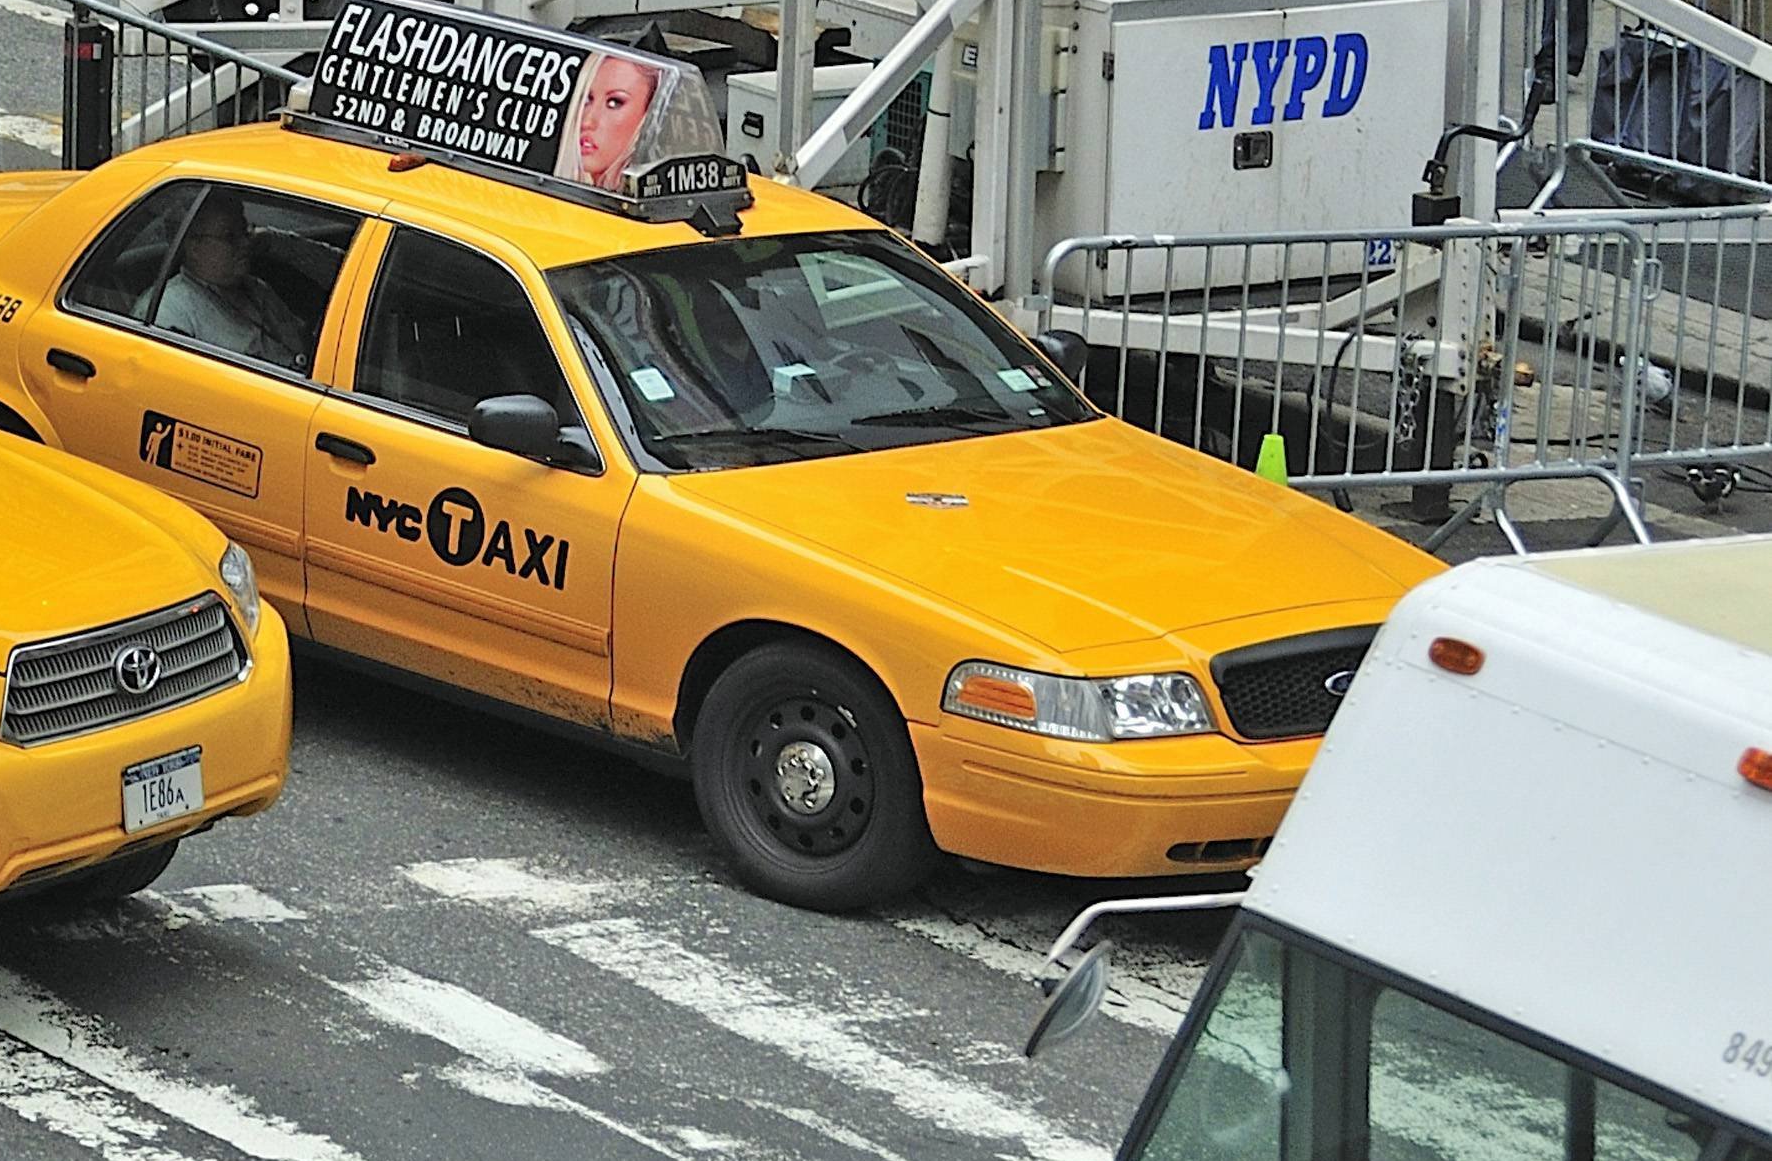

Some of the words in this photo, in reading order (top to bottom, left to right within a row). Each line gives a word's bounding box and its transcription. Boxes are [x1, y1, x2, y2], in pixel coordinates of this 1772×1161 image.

[331, 3, 581, 105] FLASHDANCERS
[1198, 32, 1371, 131] NYPD
[321, 55, 489, 122] GENTLEMEN'S
[496, 96, 558, 138] CLUB
[332, 94, 387, 128] 52ND
[390, 107, 406, 132] &
[416, 114, 532, 163] BROADWAY
[666, 161, 719, 193] 1M38
[202, 436, 231, 454] INITIAL
[235, 447, 257, 463] FARE
[345, 487, 422, 542] NYC
[427, 487, 570, 590] TAXI
